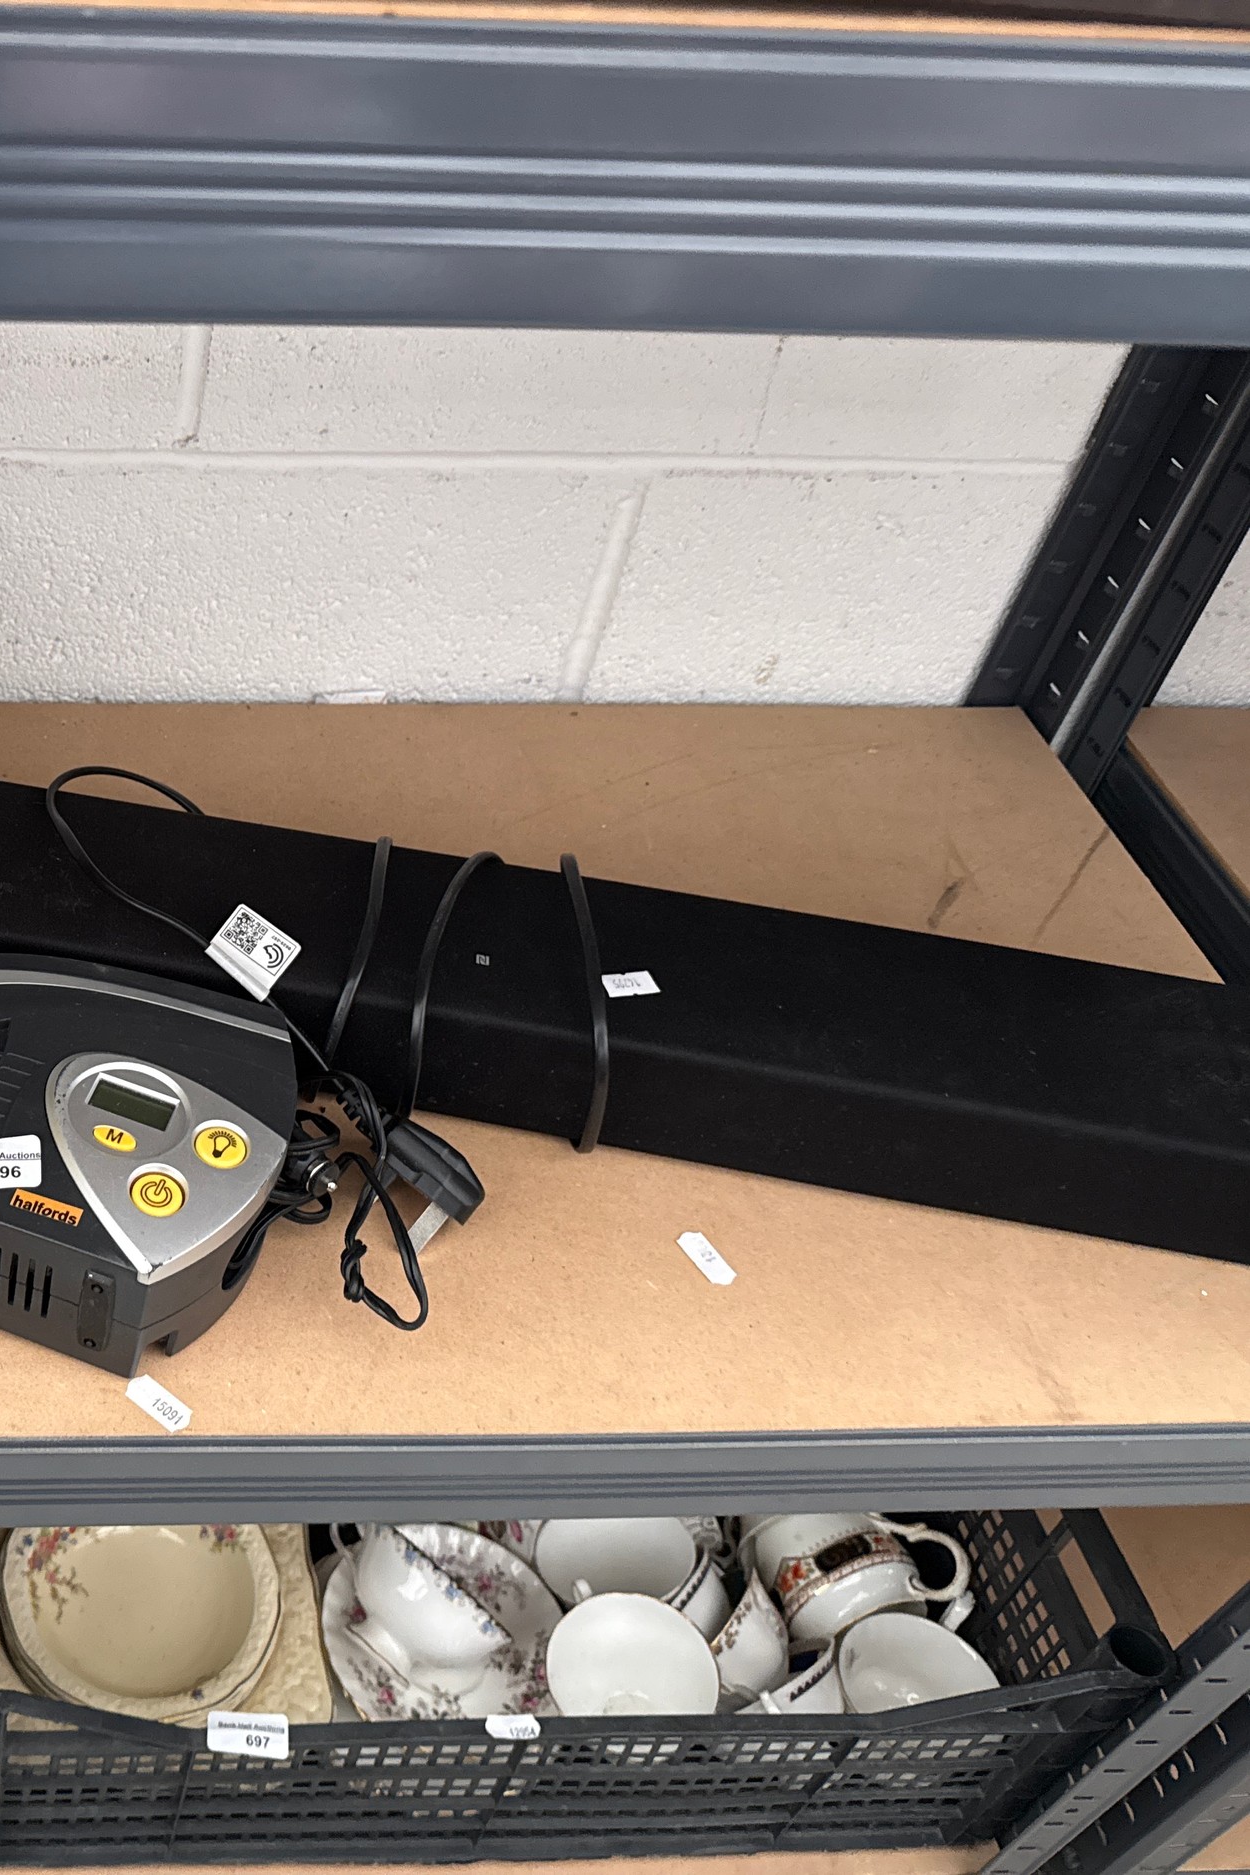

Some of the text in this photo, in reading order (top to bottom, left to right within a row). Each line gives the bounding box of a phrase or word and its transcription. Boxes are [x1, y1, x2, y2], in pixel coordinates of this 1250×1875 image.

[105, 1128, 124, 1144] M
[12, 1195, 78, 1226] halfords
[152, 1398, 184, 1425] 15091
[246, 1734, 270, 1749] 697
